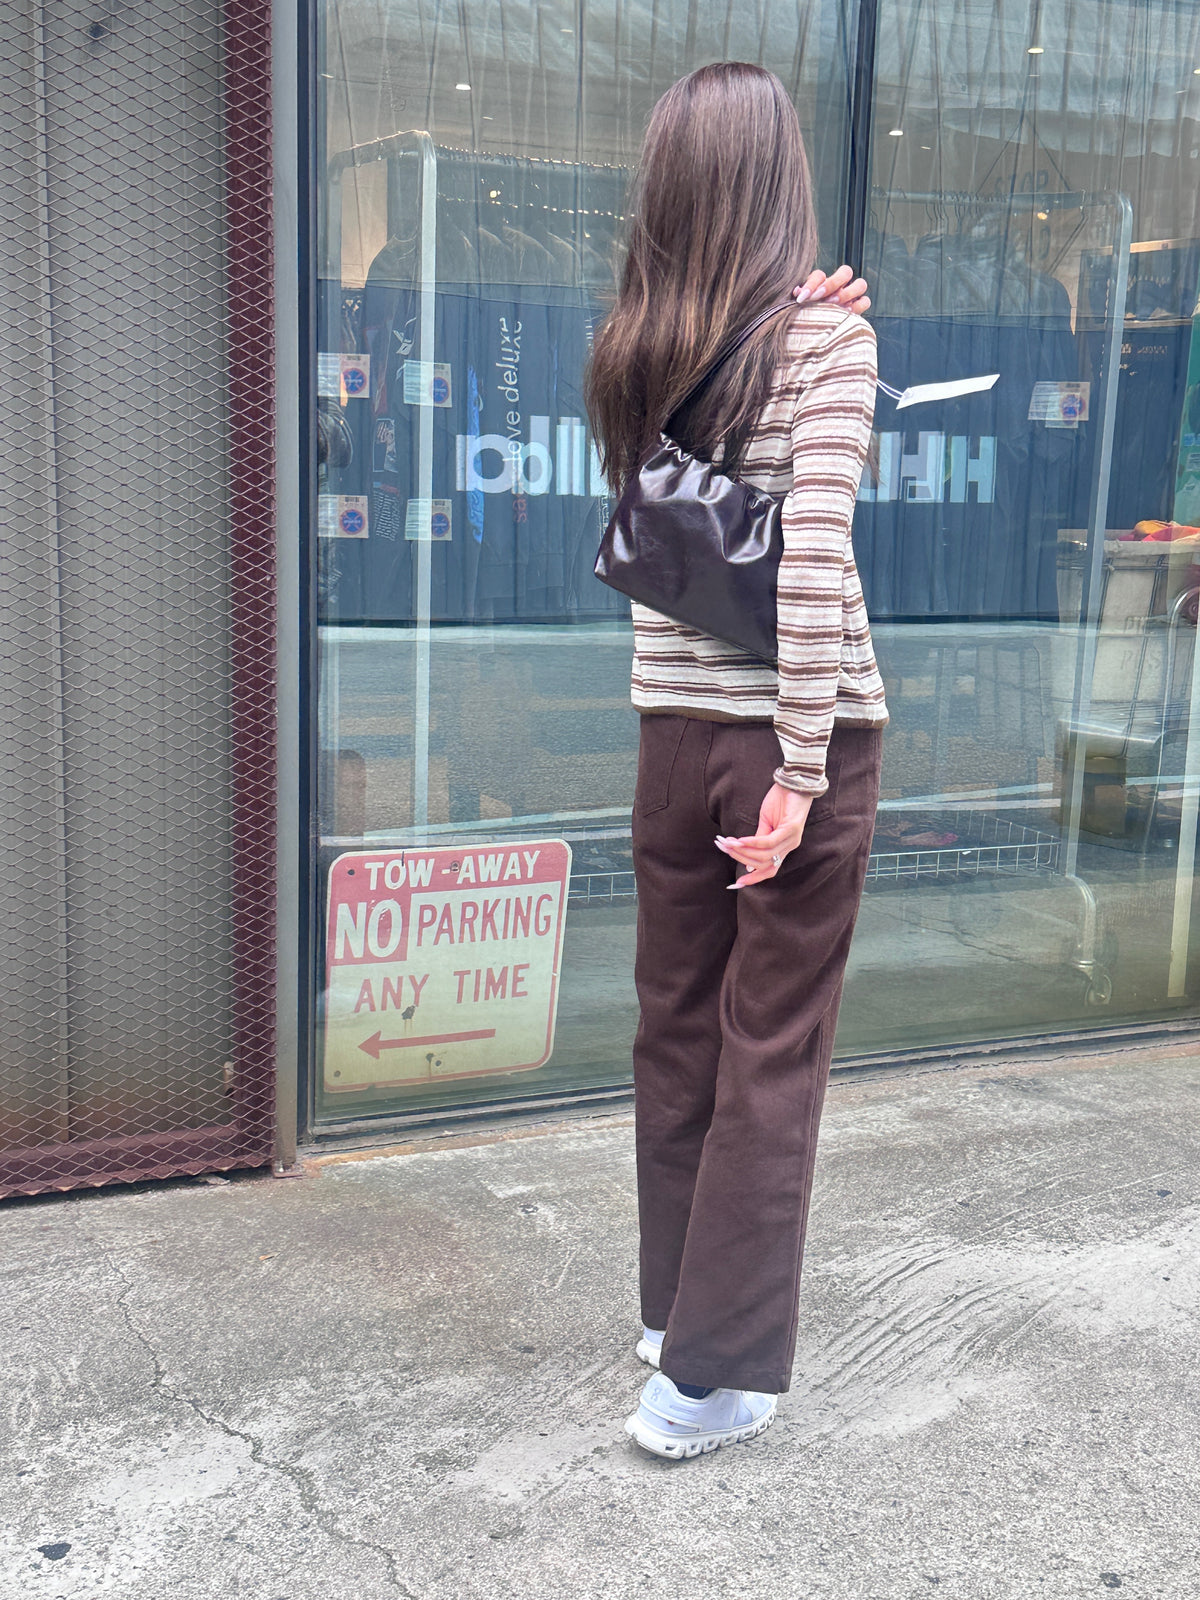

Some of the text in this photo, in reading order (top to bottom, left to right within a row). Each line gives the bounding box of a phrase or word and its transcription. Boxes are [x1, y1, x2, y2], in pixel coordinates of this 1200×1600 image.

[496, 317, 522, 403] deluxe
[503, 410, 522, 462] love
[334, 893, 553, 959] NO PARKING
[354, 963, 530, 1013] ANY TIME
